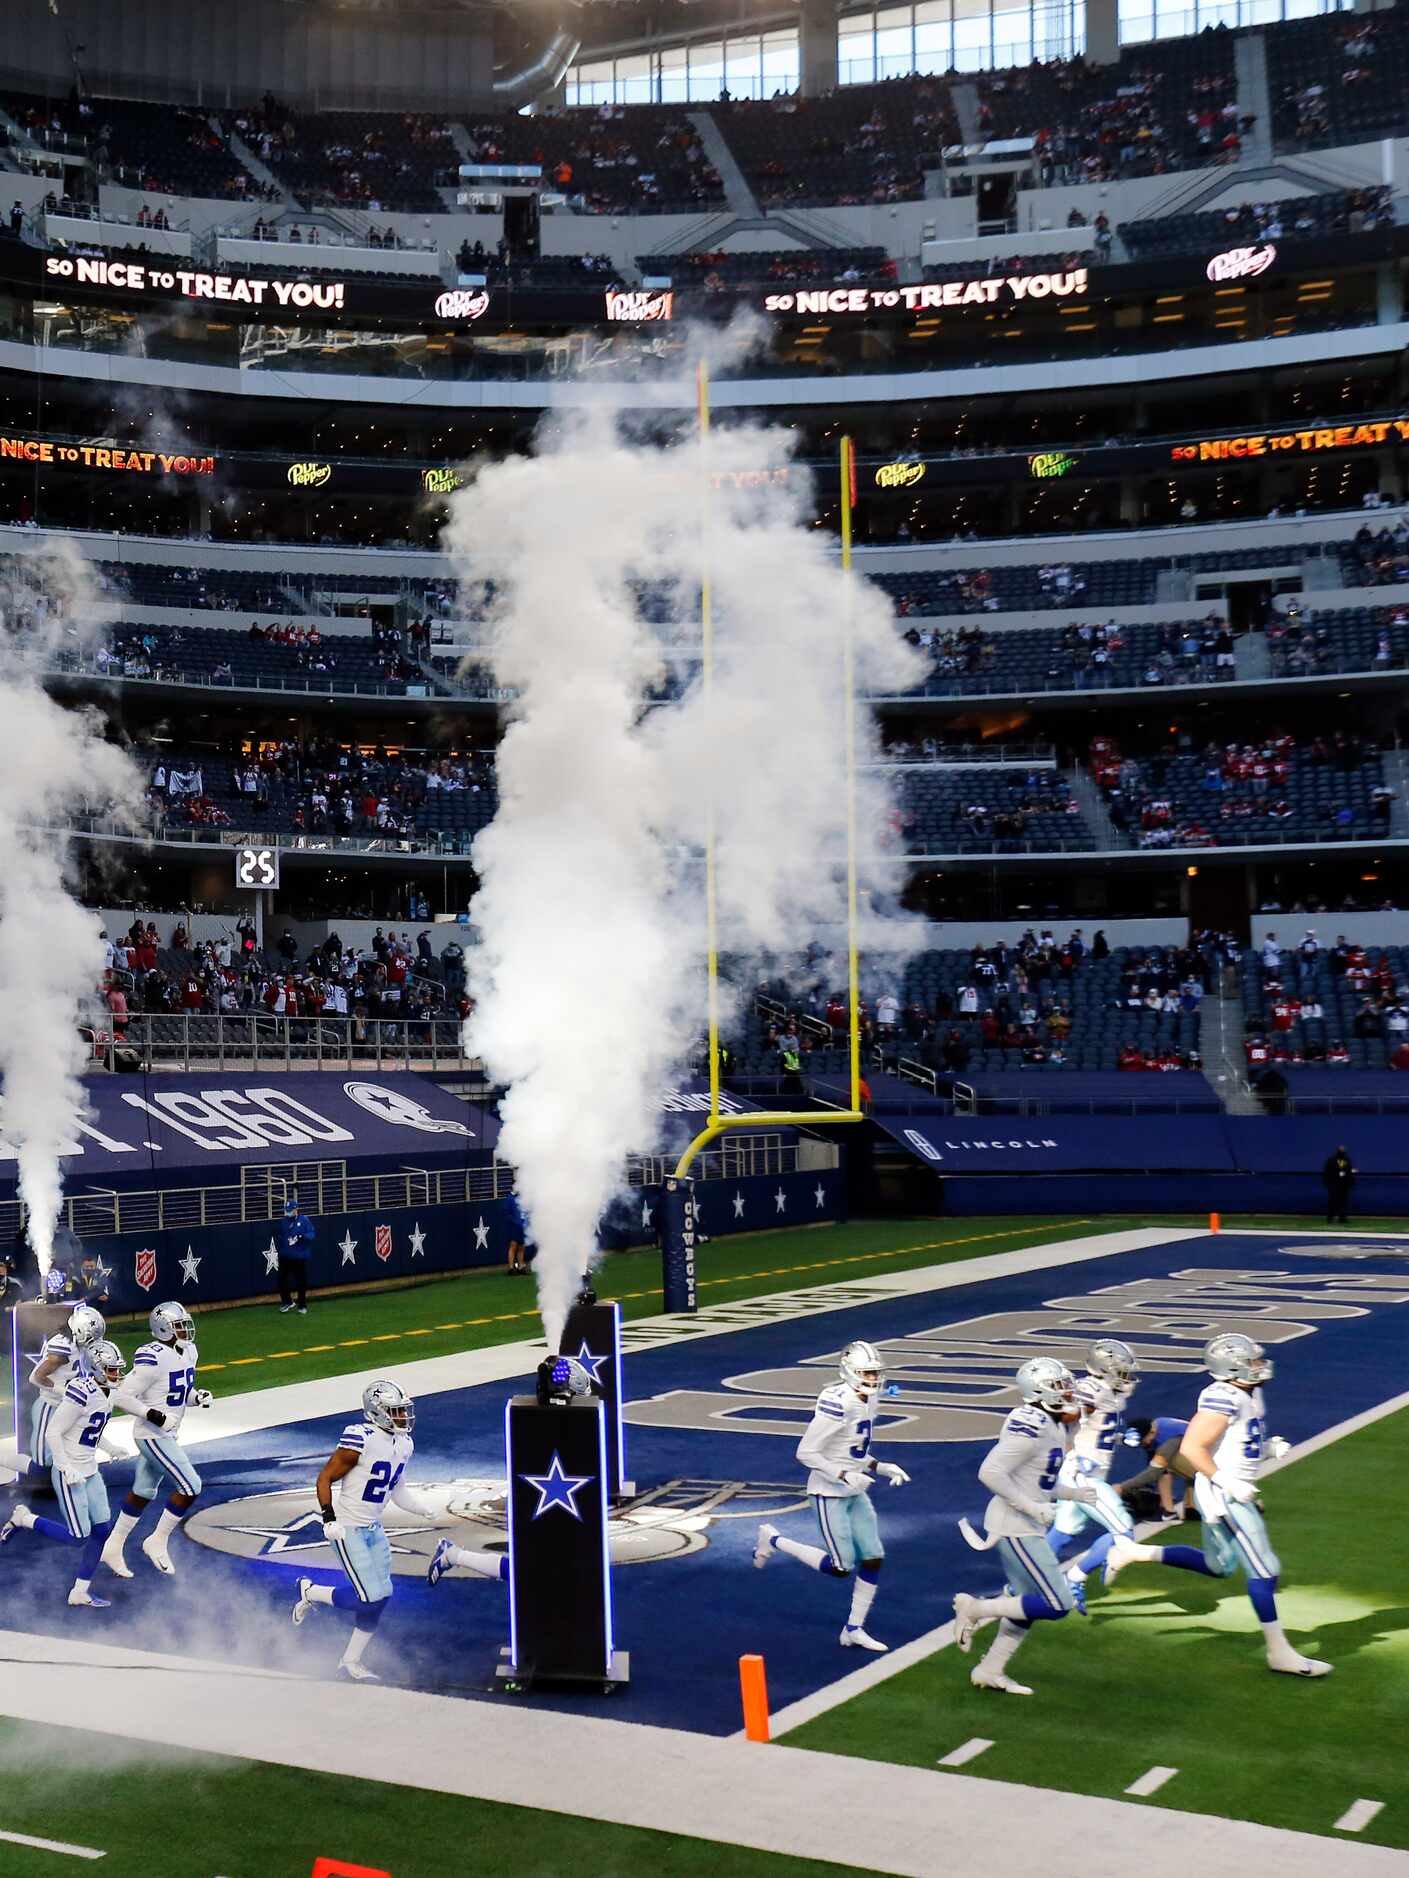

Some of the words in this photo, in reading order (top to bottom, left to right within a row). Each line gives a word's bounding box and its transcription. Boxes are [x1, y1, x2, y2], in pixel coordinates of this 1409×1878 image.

[46, 258, 73, 276] SO
[76, 258, 145, 289] NICE
[148, 271, 175, 289] TO
[176, 270, 268, 303] TREAT
[272, 280, 345, 309] YOU!
[765, 293, 793, 311] SO
[795, 288, 869, 314] NICE
[870, 290, 901, 307] TO
[900, 277, 1005, 310] TREAT
[1006, 267, 1088, 300] YOU!
[0, 437, 54, 462] NICE
[57, 447, 79, 461] TO
[79, 447, 156, 472] TREAT
[158, 454, 214, 476] YOU!
[1171, 446, 1198, 460] SO
[1199, 436, 1268, 461] NICE
[1268, 435, 1296, 450] TO
[1295, 422, 1392, 450] TREAT
[288, 463, 328, 486] Pepper
[240, 850, 275, 884] 25
[188, 982, 198, 992] 10
[121, 1087, 355, 1151] 1960
[945, 1139, 1059, 1149] LINCOLN
[682, 1201, 695, 1307] COWBOYS
[669, 1286, 907, 1324] RACISM
[620, 1267, 1409, 1443] COWBOYS
